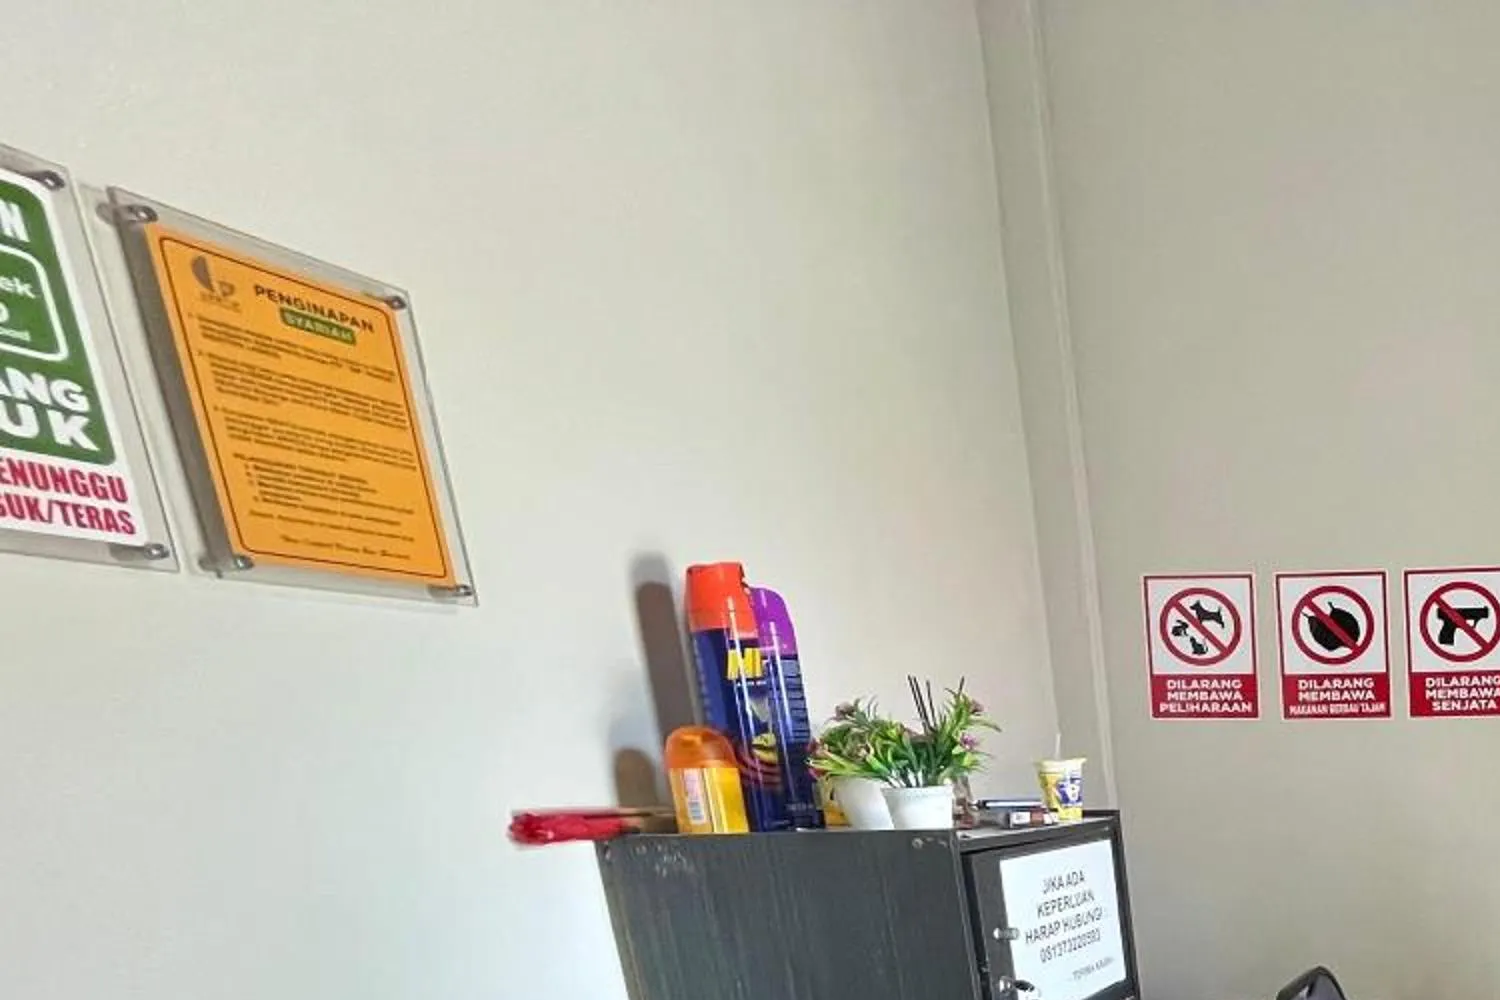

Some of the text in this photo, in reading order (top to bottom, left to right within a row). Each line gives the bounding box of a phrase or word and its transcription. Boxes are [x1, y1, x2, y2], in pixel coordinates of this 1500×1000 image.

[253, 284, 374, 333] PENGINAPAN
[1166, 679, 1243, 689] DILARANG
[1297, 677, 1375, 690] DILARANG
[1167, 690, 1243, 701] MEMBAWA
[1297, 690, 1376, 702] MEMBAWA
[1159, 702, 1253, 712] PELIHARAAN
[1431, 699, 1498, 711] SENJATA
[1066, 869, 1085, 887] ADA
[1025, 920, 1061, 945] HARAP
